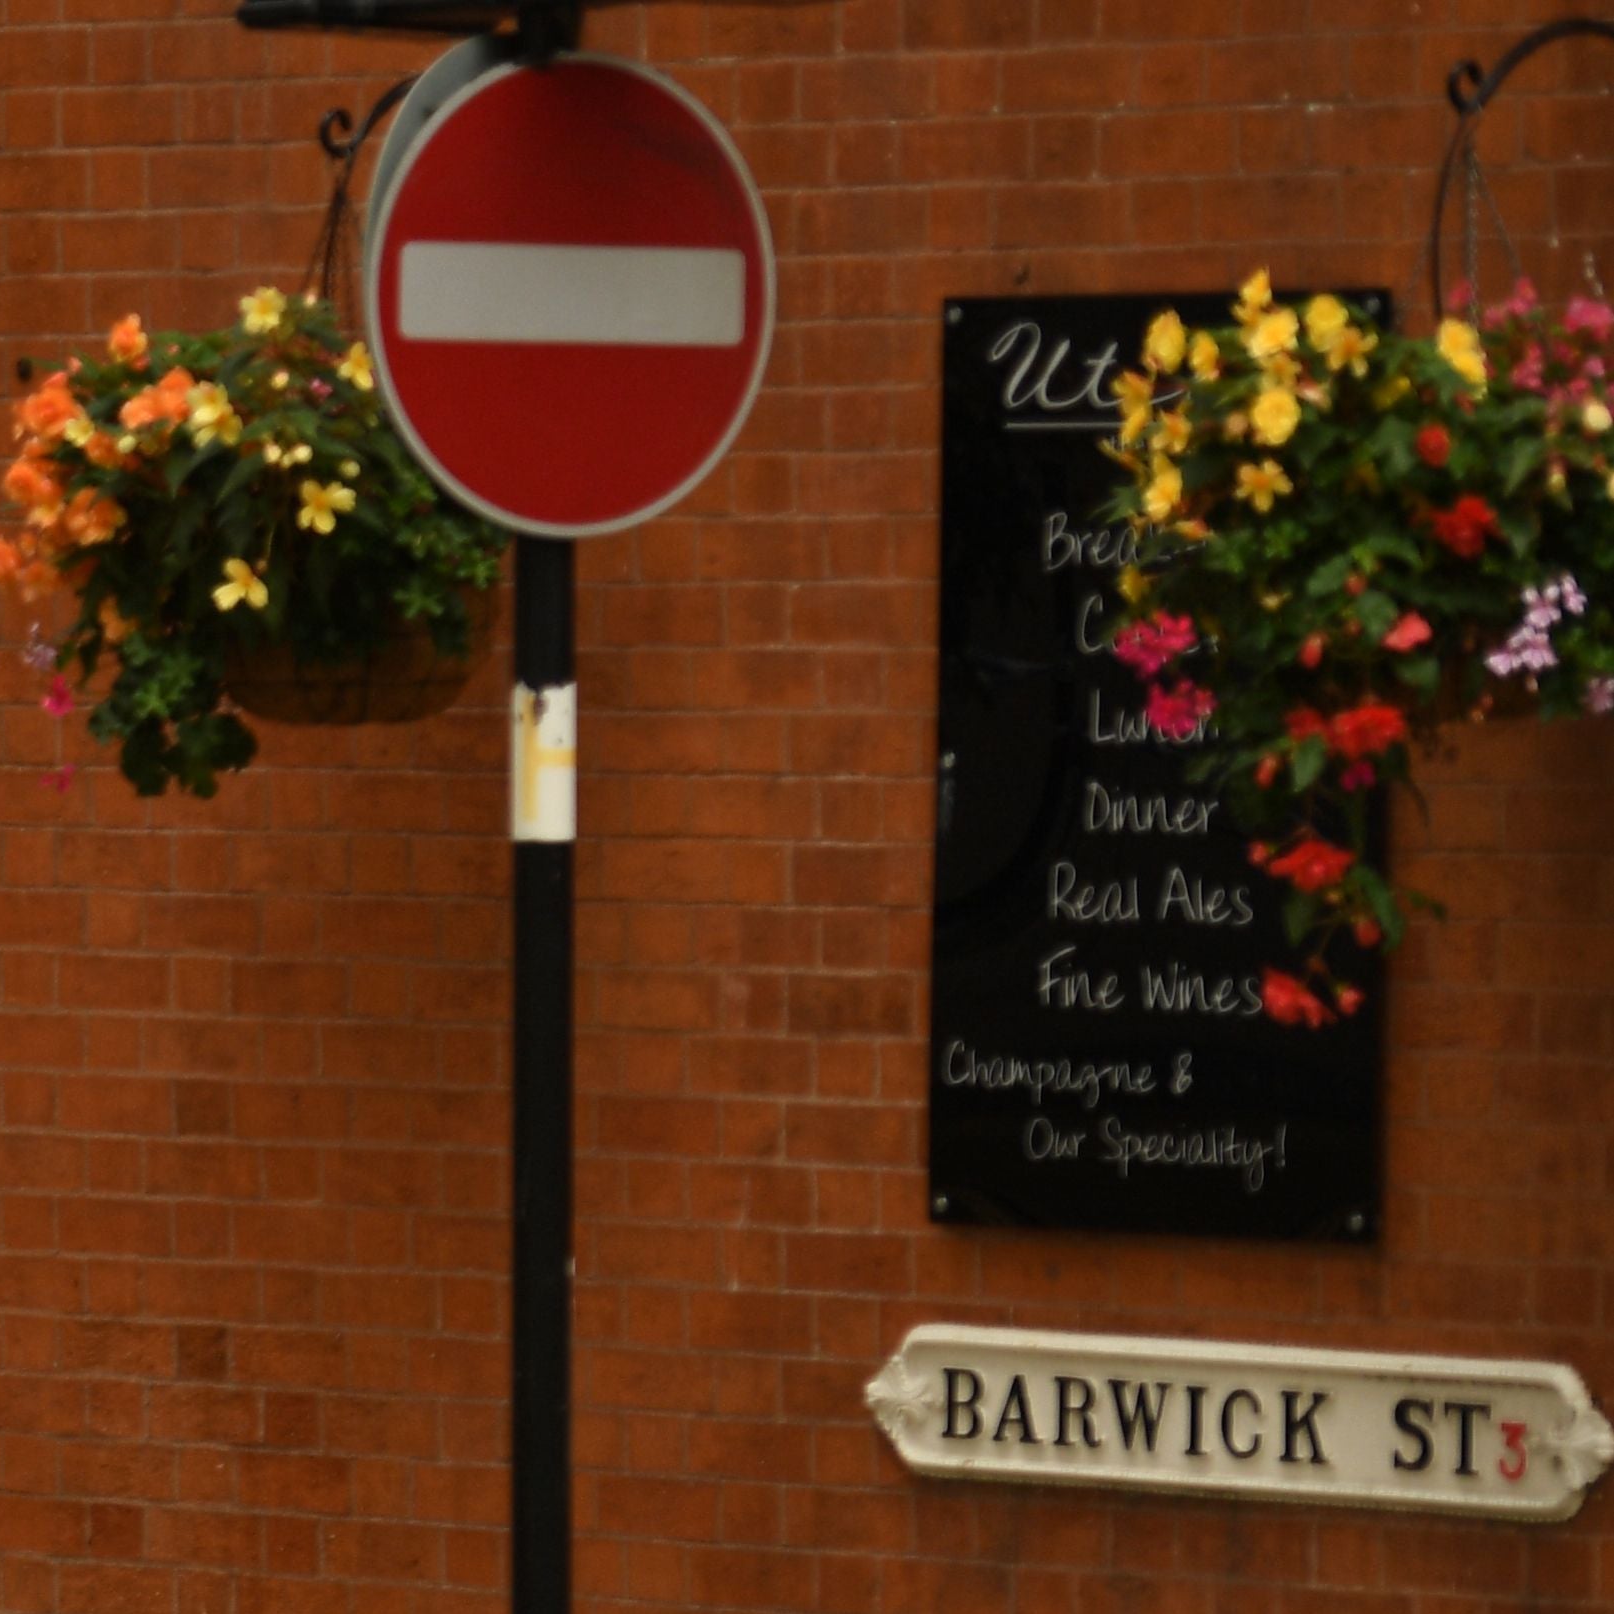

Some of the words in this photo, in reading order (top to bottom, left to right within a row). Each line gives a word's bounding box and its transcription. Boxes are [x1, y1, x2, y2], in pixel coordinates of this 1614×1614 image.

[1085, 781, 1219, 834] Dinner
[1048, 861, 1141, 922] Real
[1157, 866, 1255, 925] Ales
[1038, 945, 1125, 1010] Fine
[1141, 961, 1263, 1015] Wines
[943, 1039, 1158, 1108] Champagne
[1026, 1117, 1087, 1161] Our
[940, 1367, 1330, 1465] BARWICK
